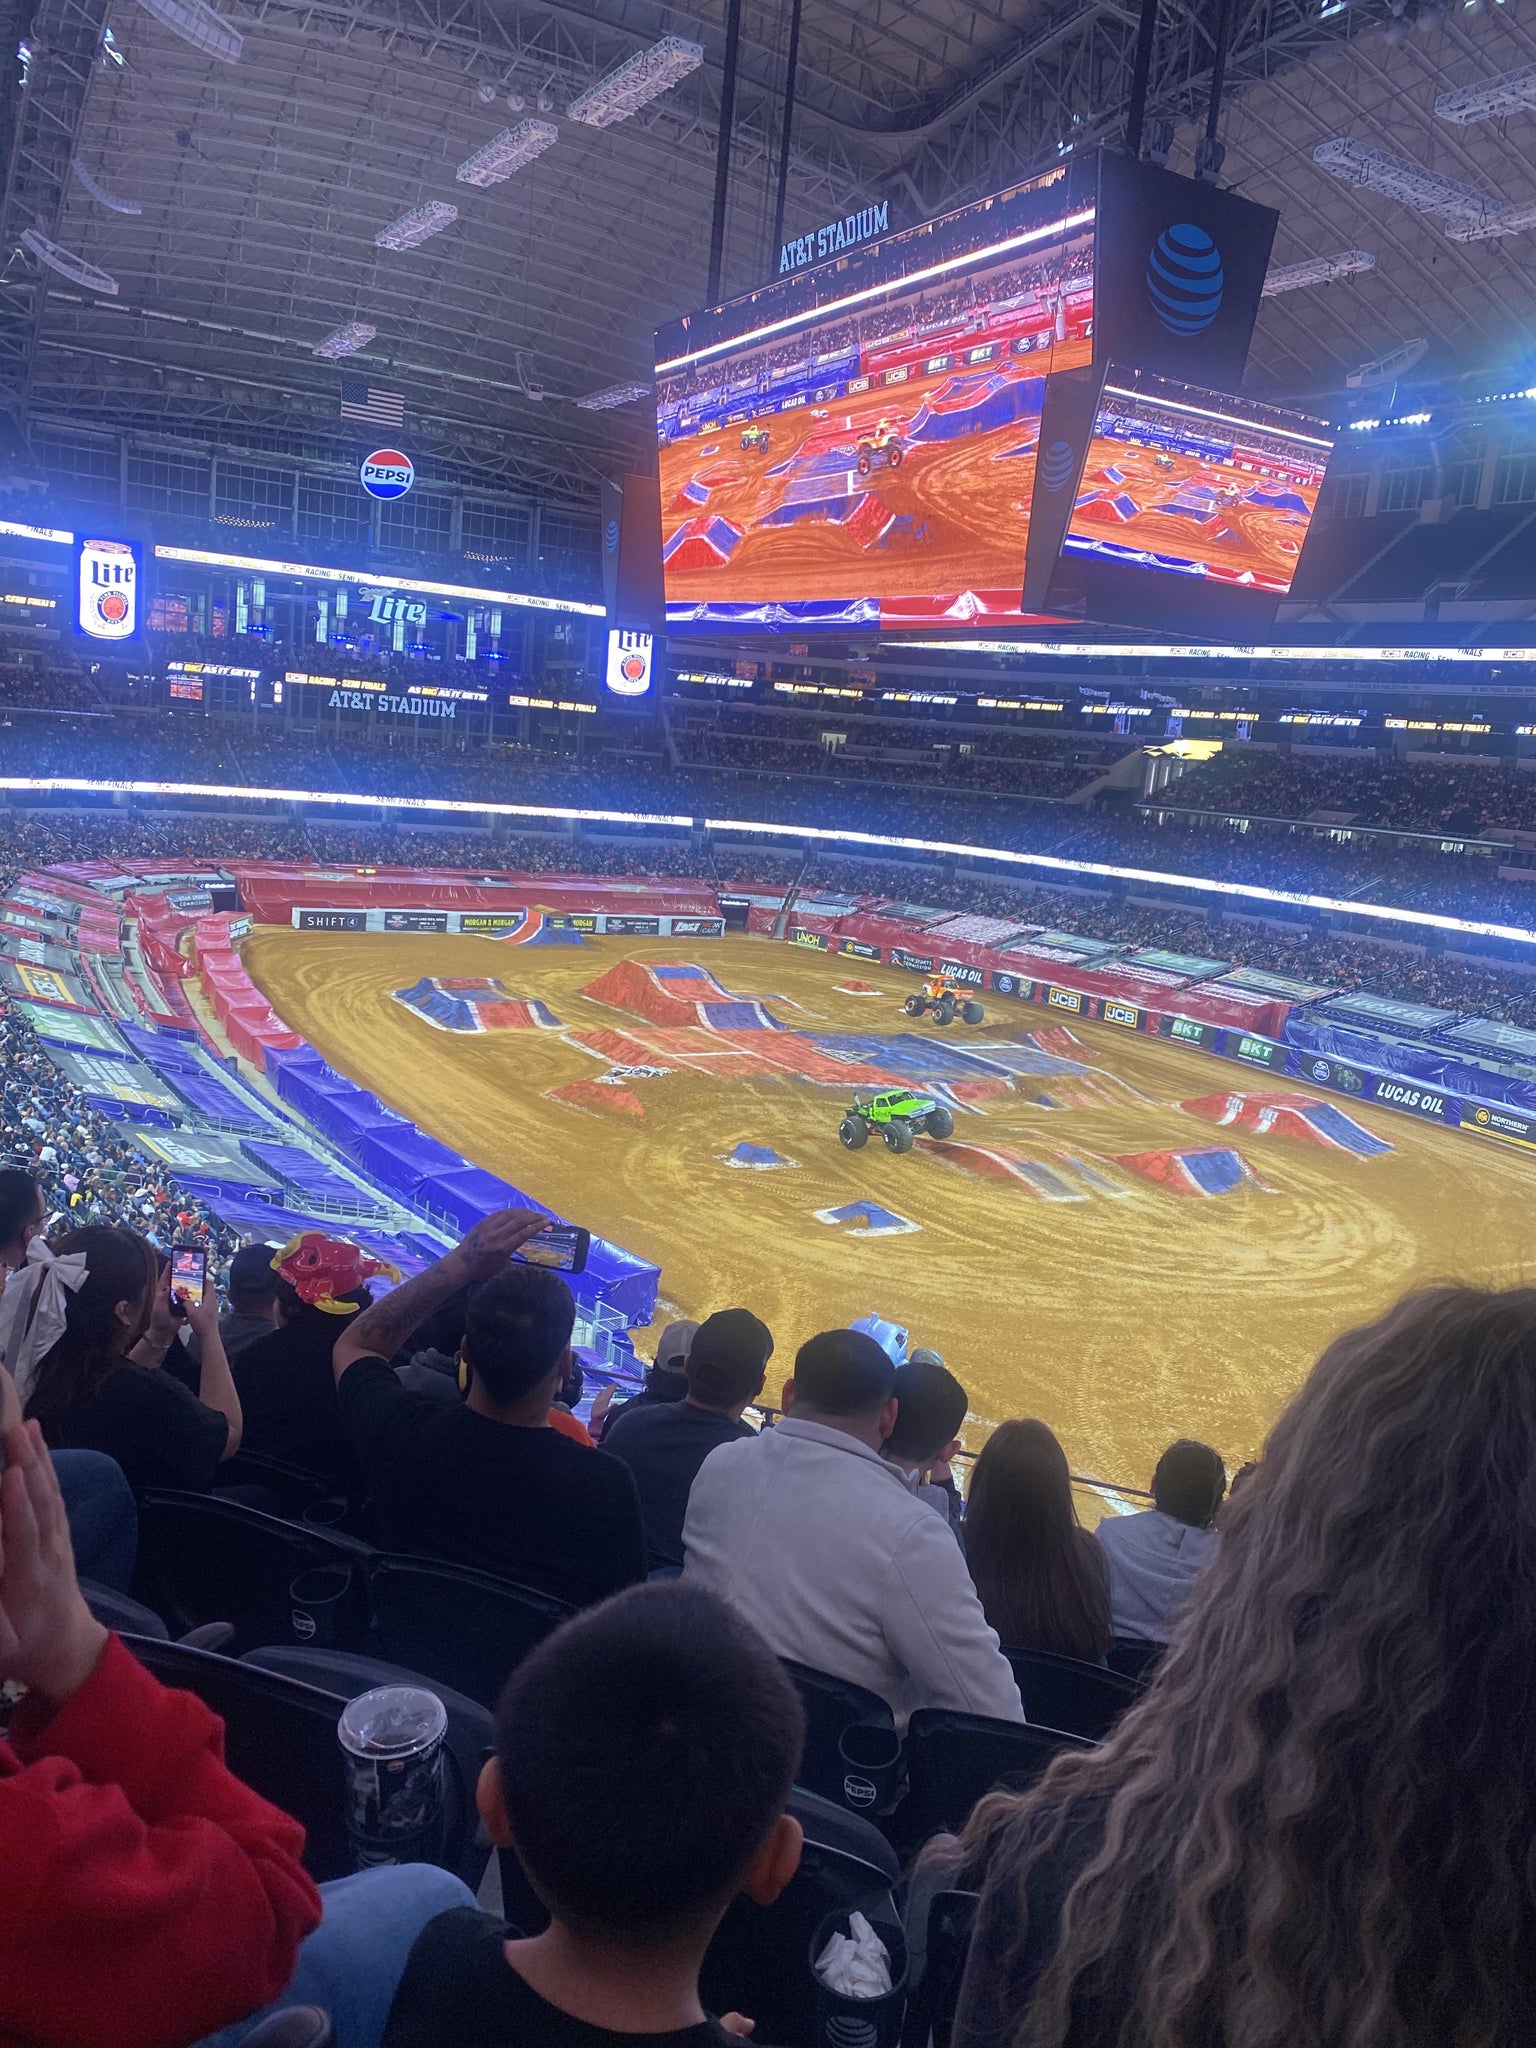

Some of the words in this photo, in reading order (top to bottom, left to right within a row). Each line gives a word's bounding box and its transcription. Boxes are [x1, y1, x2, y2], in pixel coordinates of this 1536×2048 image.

[779, 233, 815, 273] AT&T
[818, 200, 889, 257] STADIUM
[887, 370, 906, 383] JCB
[850, 379, 868, 391] JCB
[364, 466, 411, 483] PEPSI
[91, 560, 134, 588] Lite
[305, 568, 331, 578] RACING
[527, 597, 550, 607] RACING
[367, 595, 426, 624] Lite
[1189, 648, 1210, 657] RACING
[1402, 651, 1429, 661] RACING
[167, 661, 184, 671] AS
[201, 665, 217, 674] AS
[308, 676, 337, 687] RACING
[361, 680, 387, 691] FINALS
[407, 686, 422, 694] AS
[437, 689, 451, 698] AS
[328, 690, 374, 710] AT&T
[378, 695, 457, 718] STADIUM
[575, 703, 597, 713] FINALS
[1081, 705, 1094, 713] AS
[1279, 715, 1293, 723] AS
[1309, 717, 1322, 725] AS
[1408, 721, 1437, 730] RACING
[1463, 724, 1492, 733] FINALS
[1515, 726, 1533, 735] AS
[307, 916, 346, 927] SHIFT
[464, 918, 488, 926] MORGAN
[796, 933, 820, 946] UNOH
[940, 963, 968, 981] LUCAS
[968, 971, 983, 985] OIL
[1051, 992, 1079, 1008] JCB
[1107, 1007, 1136, 1024] JCB
[1173, 1021, 1203, 1038] BKT
[1239, 1040, 1273, 1057] BKT
[1376, 1082, 1420, 1107] LUCAS
[1491, 1114, 1528, 1131] NORTHERN
[845, 1782, 875, 1797] PEPSI
